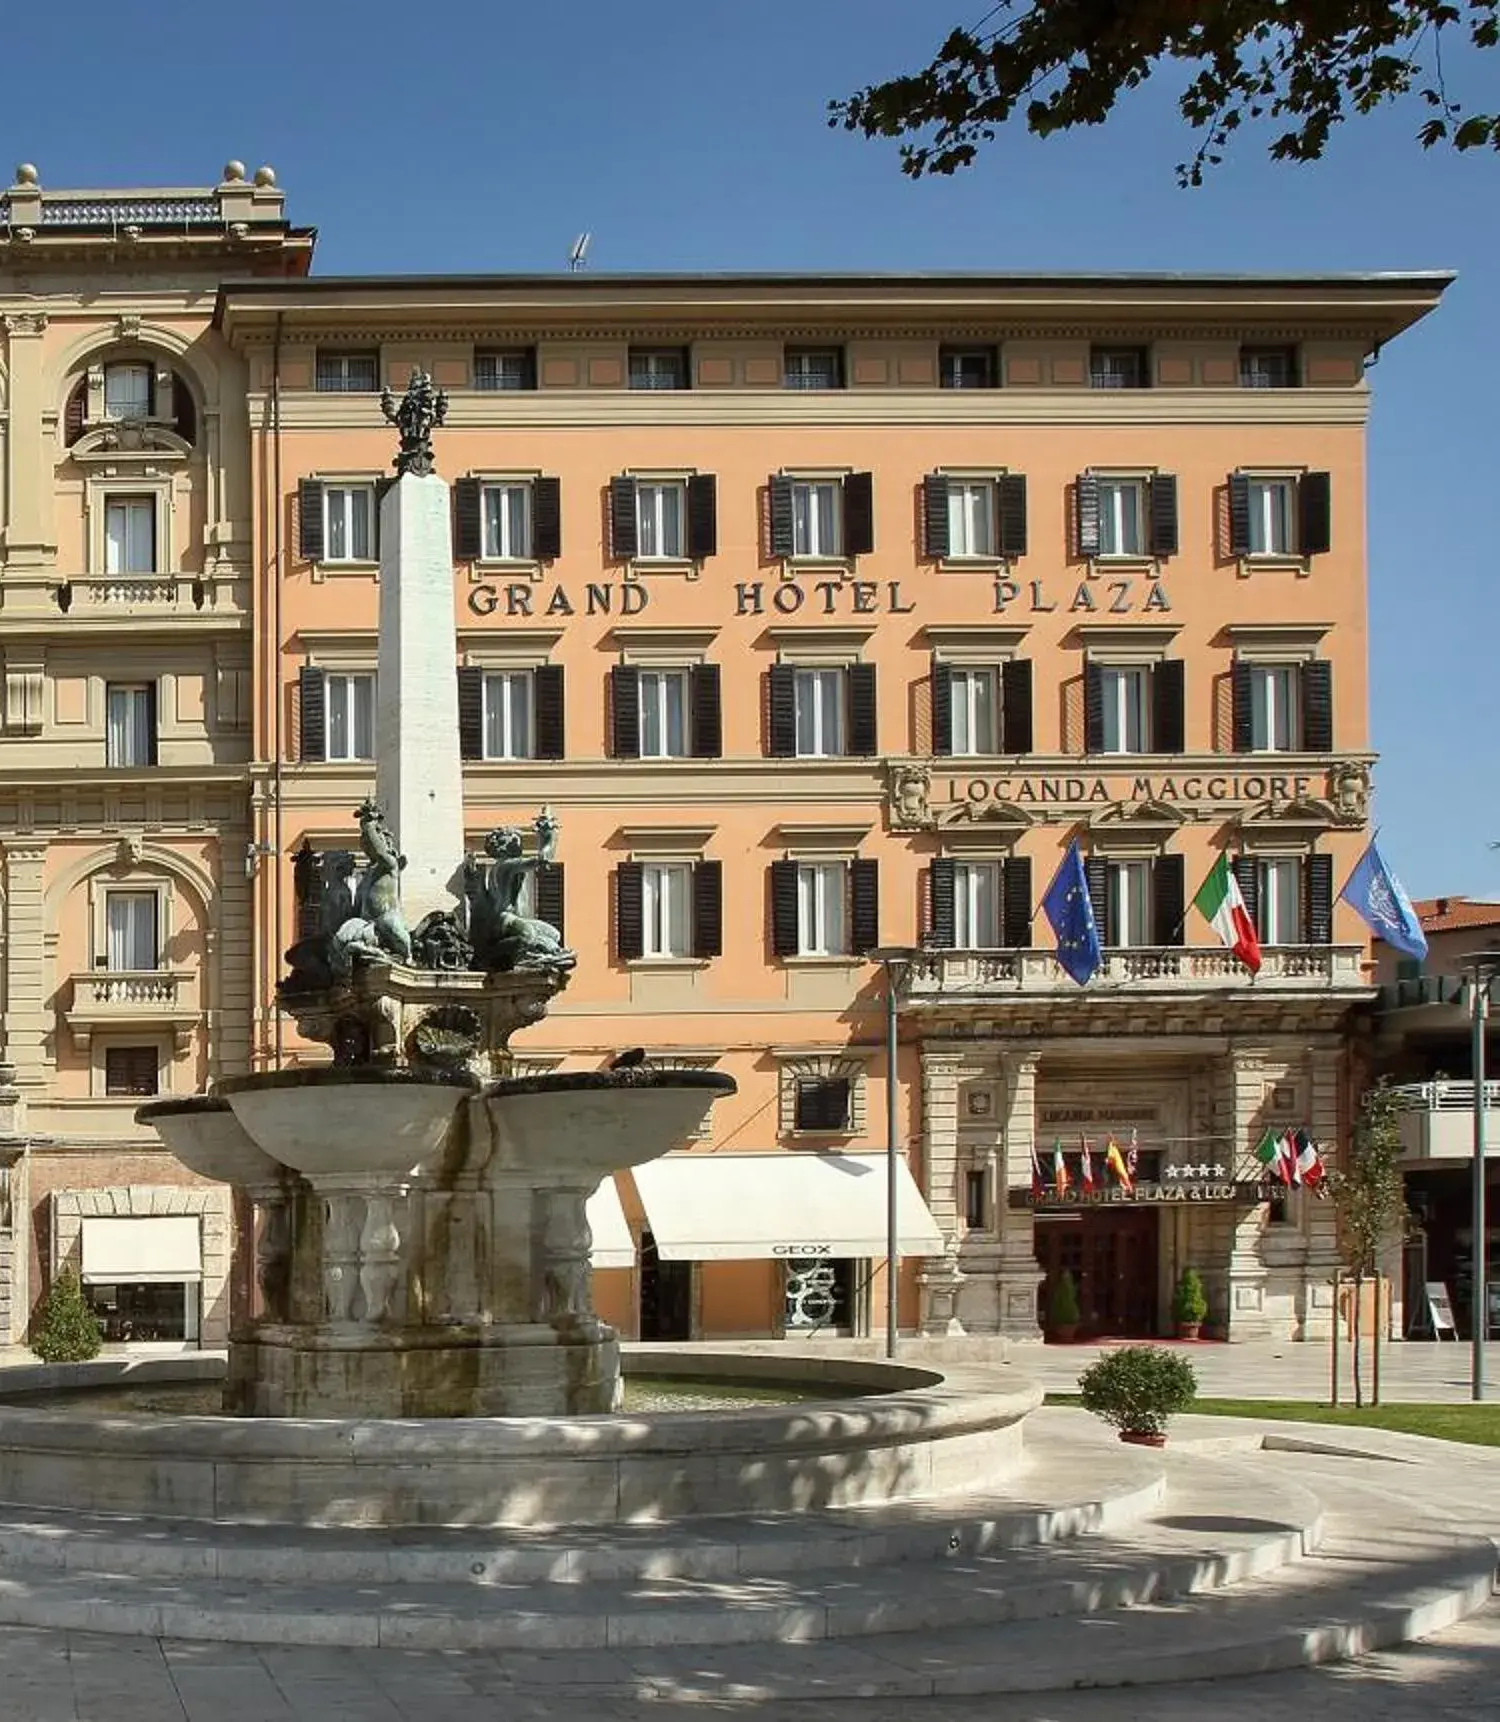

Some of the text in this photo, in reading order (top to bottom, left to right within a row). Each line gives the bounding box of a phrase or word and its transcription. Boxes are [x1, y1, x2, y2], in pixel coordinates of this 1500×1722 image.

[467, 579, 1172, 616] GRAND HOTEL PLAZA
[949, 777, 1311, 802] LOCANDA MAGGIORE
[1135, 1185, 1186, 1201] PLAZA
[1189, 1185, 1201, 1200] &
[772, 1245, 831, 1255] GEOX
